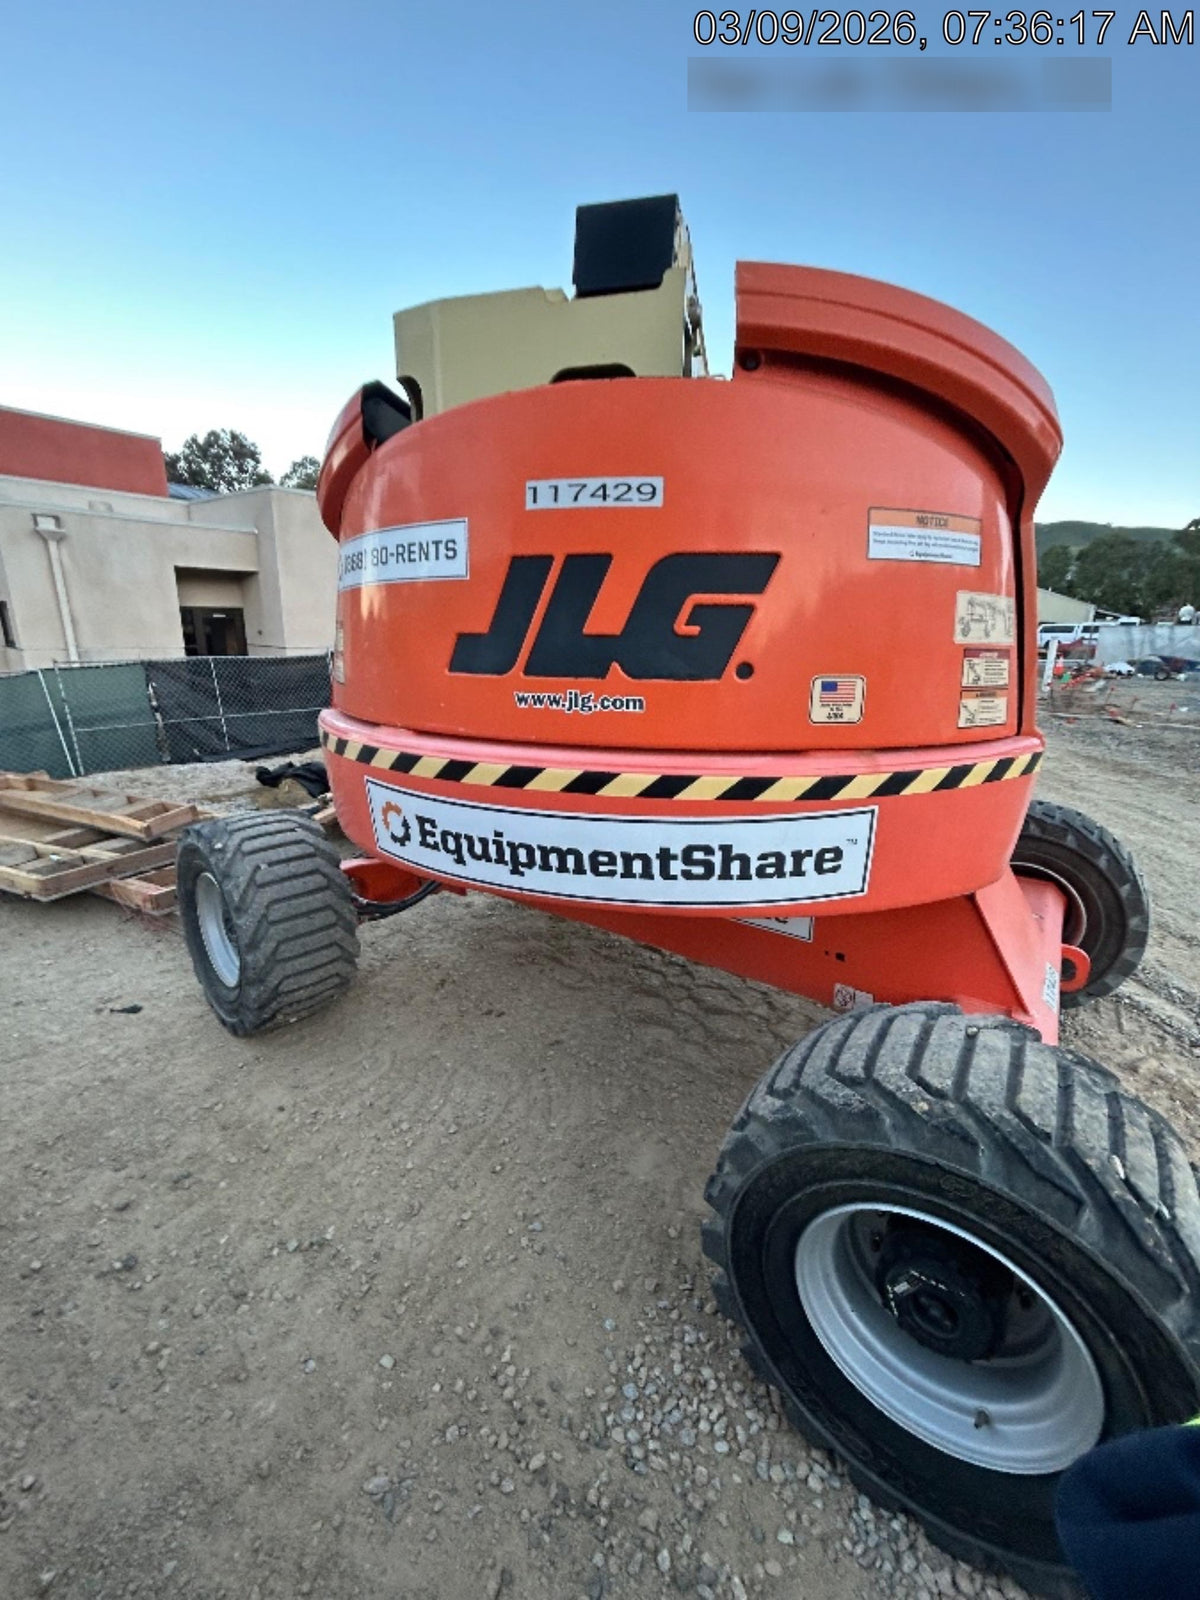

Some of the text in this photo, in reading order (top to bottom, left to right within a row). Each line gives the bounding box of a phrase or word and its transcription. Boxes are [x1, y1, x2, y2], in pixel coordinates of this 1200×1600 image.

[528, 482, 657, 504] 117429
[371, 538, 458, 567] 80-RENTS
[515, 690, 645, 713] www.jlg.com
[415, 814, 844, 881] EquipmentShare
